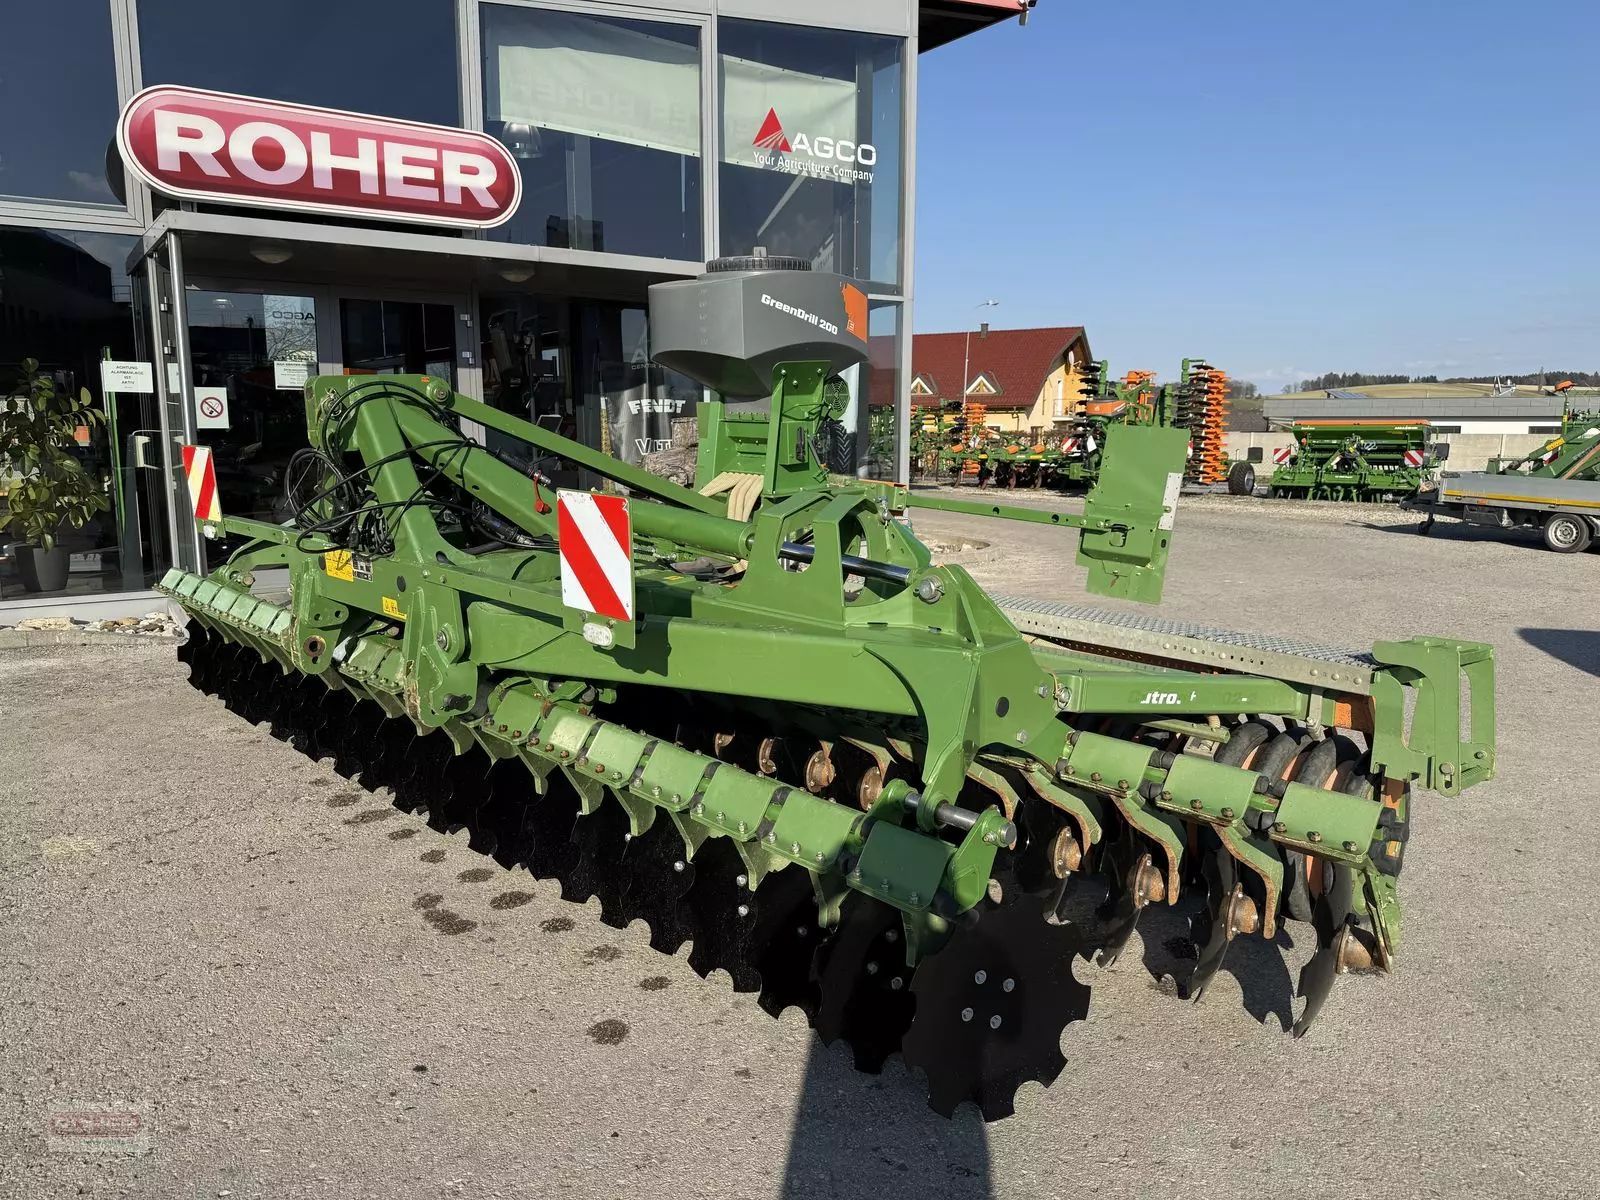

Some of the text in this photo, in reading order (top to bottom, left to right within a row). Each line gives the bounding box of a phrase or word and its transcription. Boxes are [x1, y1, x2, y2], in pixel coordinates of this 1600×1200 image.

[154, 109, 500, 209] ROHER
[791, 132, 877, 166] AGCO
[753, 151, 874, 184] Your Agriculture Company
[760, 293, 838, 335] GreenDrill 200
[627, 398, 686, 415] FENDT
